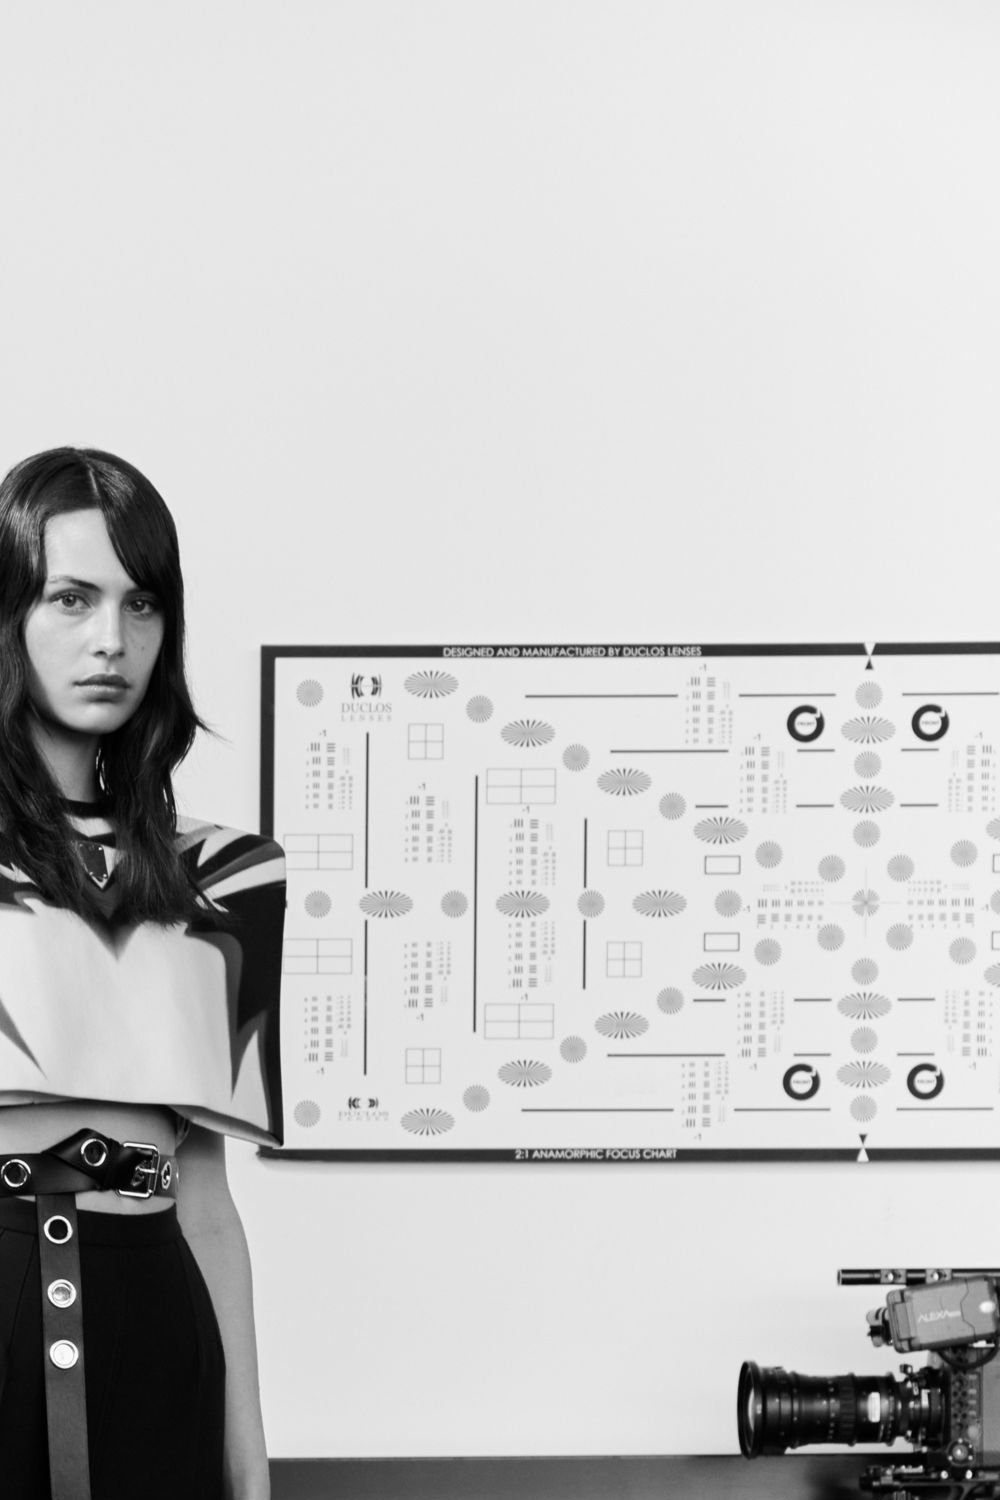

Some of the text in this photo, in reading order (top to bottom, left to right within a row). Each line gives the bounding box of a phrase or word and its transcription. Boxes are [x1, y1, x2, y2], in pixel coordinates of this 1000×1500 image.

[443, 646, 702, 657] DESIGNED AND MANUFACTURED BY DUCLOS LENSES
[341, 702, 392, 713] DUCLOS
[341, 714, 392, 722] LENSES
[515, 1149, 677, 1159] 2:1 ANAMORPHIC FOCUS CHART
[918, 1309, 949, 1323] ALEXA
